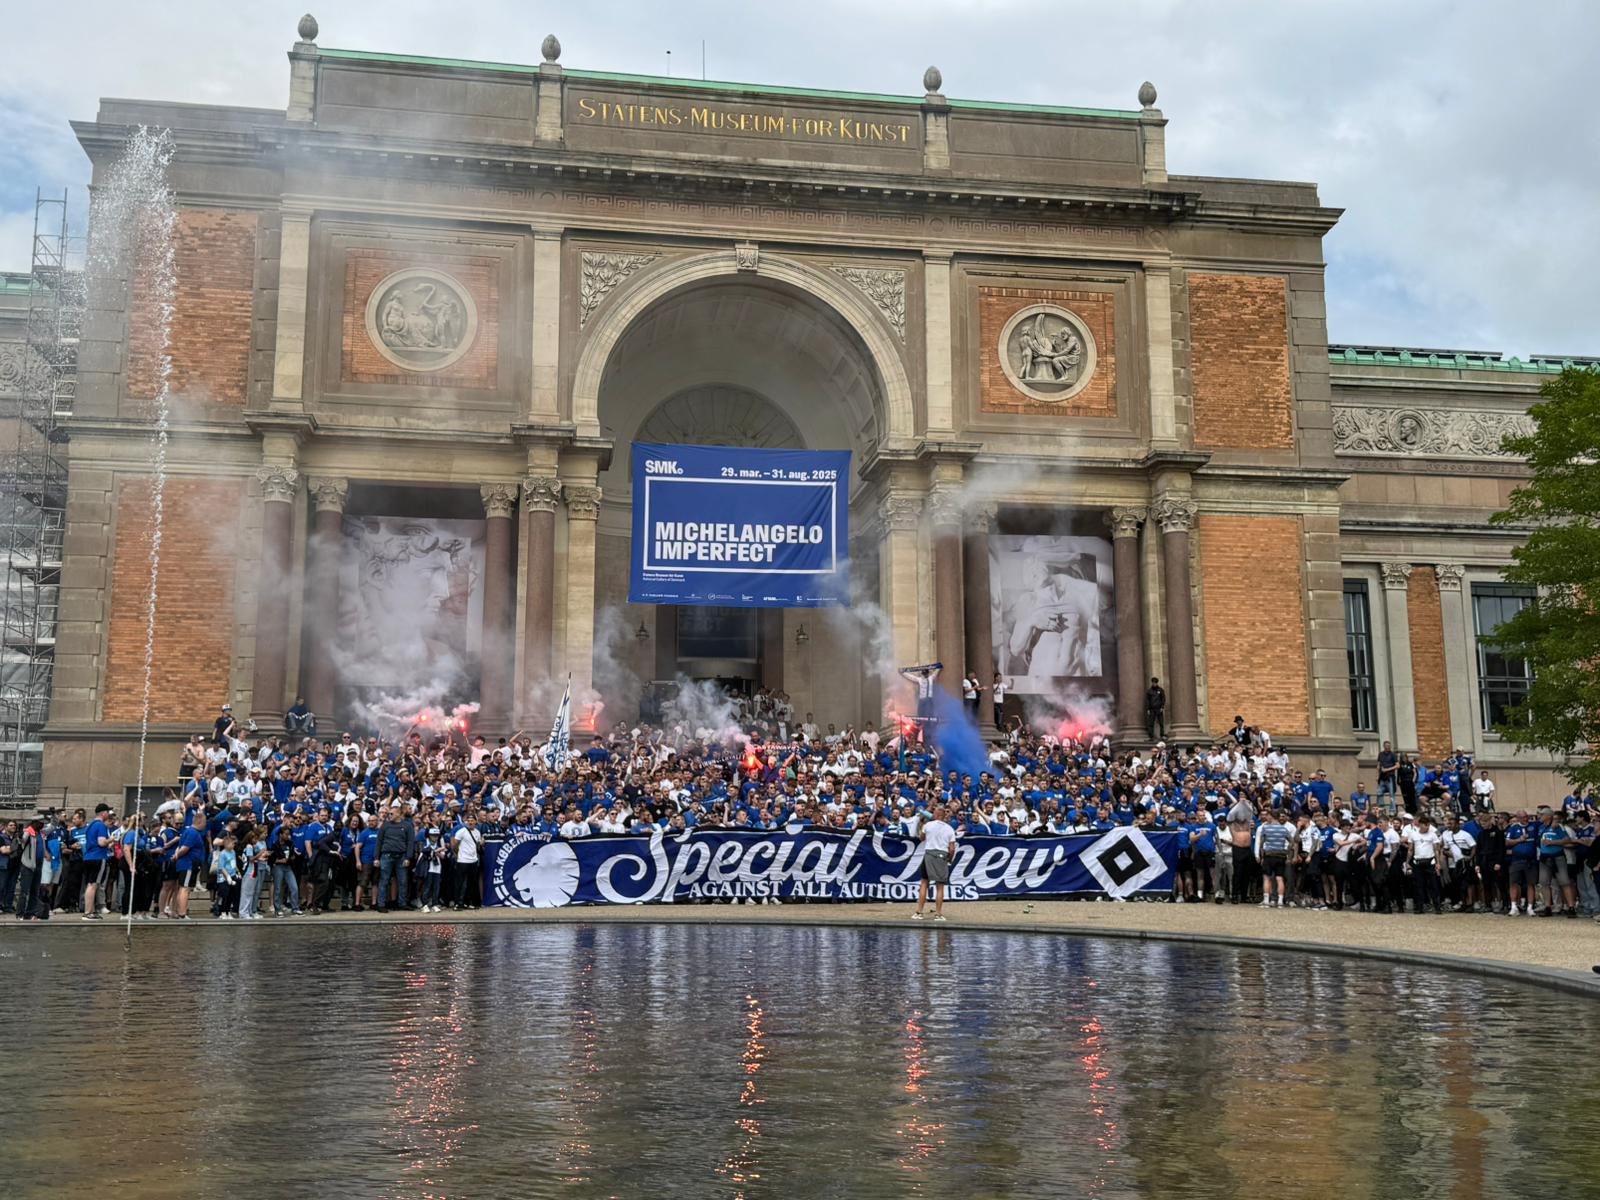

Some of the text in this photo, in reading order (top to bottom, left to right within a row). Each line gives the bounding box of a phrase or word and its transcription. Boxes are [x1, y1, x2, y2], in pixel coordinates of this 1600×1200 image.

[578, 97, 910, 142] STATENS MUSEUM FOR KUNST
[721, 467, 737, 477] 29.
[740, 470, 762, 478] mar.
[789, 472, 810, 481] aug.
[812, 470, 837, 480] 2025
[655, 522, 823, 544] MICHELANGELO
[655, 541, 777, 562] IMPERFECT
[595, 823, 868, 904] Special
[688, 881, 979, 900] AGAINST ALL AUTHORTIES
